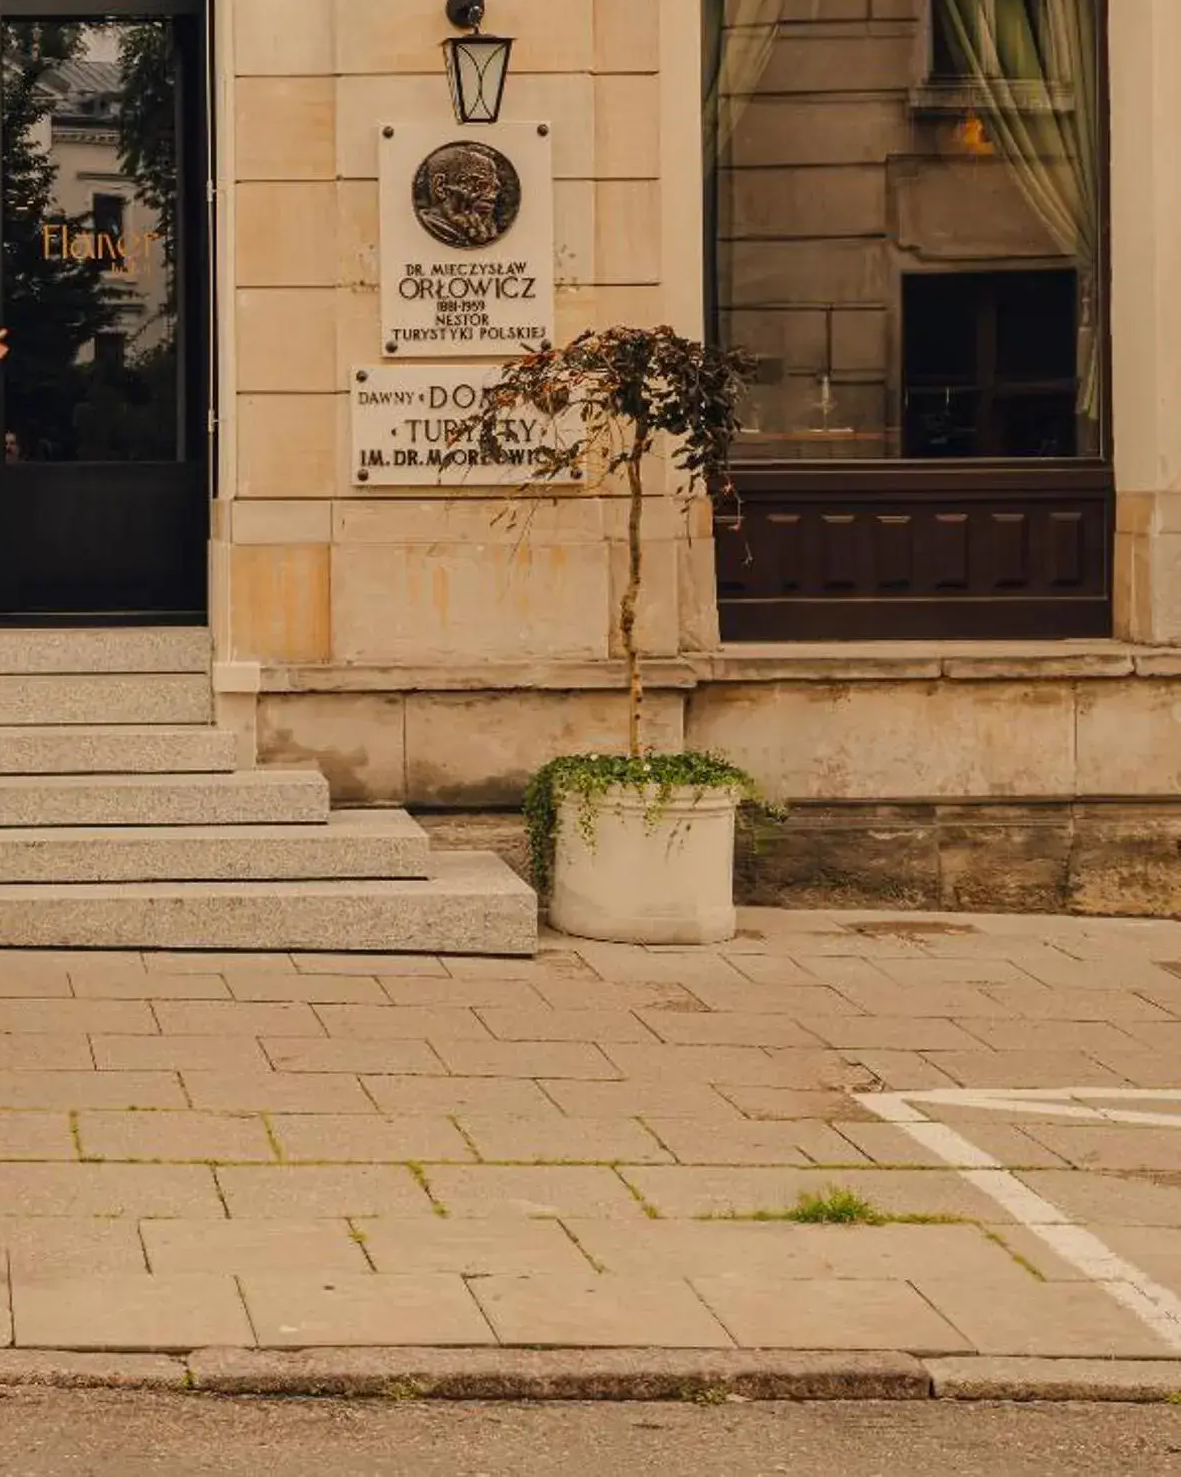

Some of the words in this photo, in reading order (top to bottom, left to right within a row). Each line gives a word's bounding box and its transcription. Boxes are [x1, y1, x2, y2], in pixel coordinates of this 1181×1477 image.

[43, 224, 159, 260] Flaner
[431, 262, 527, 276] MIECZYSŁAW
[399, 276, 536, 300] ORŁOWICZ
[435, 313, 490, 326] NESTOR
[393, 327, 474, 341] TURYSTYKI
[479, 326, 546, 340] POLSKIEJ
[358, 391, 414, 405] DAWNY
[405, 419, 537, 442] TURYTY
